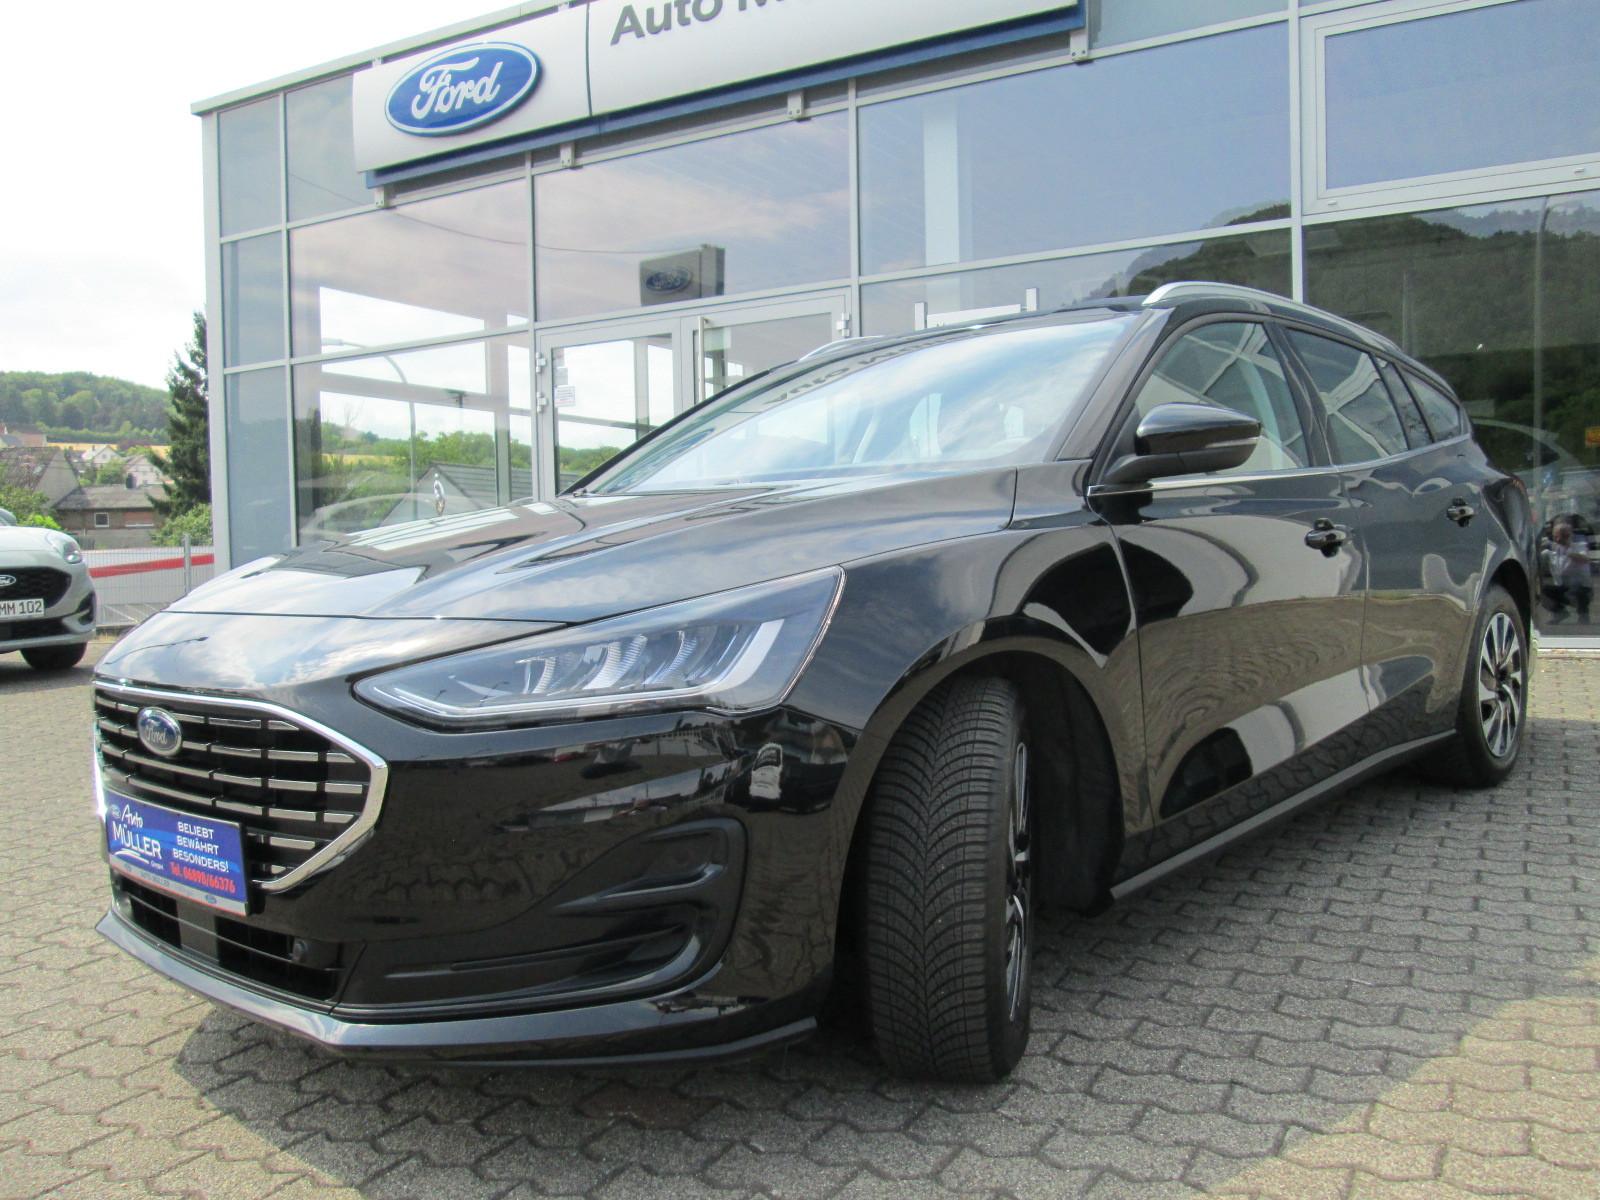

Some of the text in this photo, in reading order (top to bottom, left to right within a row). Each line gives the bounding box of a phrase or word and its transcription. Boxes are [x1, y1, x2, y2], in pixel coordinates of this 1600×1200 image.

[611, 0, 722, 46] Auto
[410, 57, 501, 120] Ford
[19, 600, 42, 614] 102
[122, 804, 143, 828] Auto
[112, 820, 162, 860] MÜLLER
[177, 821, 214, 839] BELIEBT
[176, 835, 219, 855] BEWÄHRT
[172, 847, 229, 873] BESONDERS!
